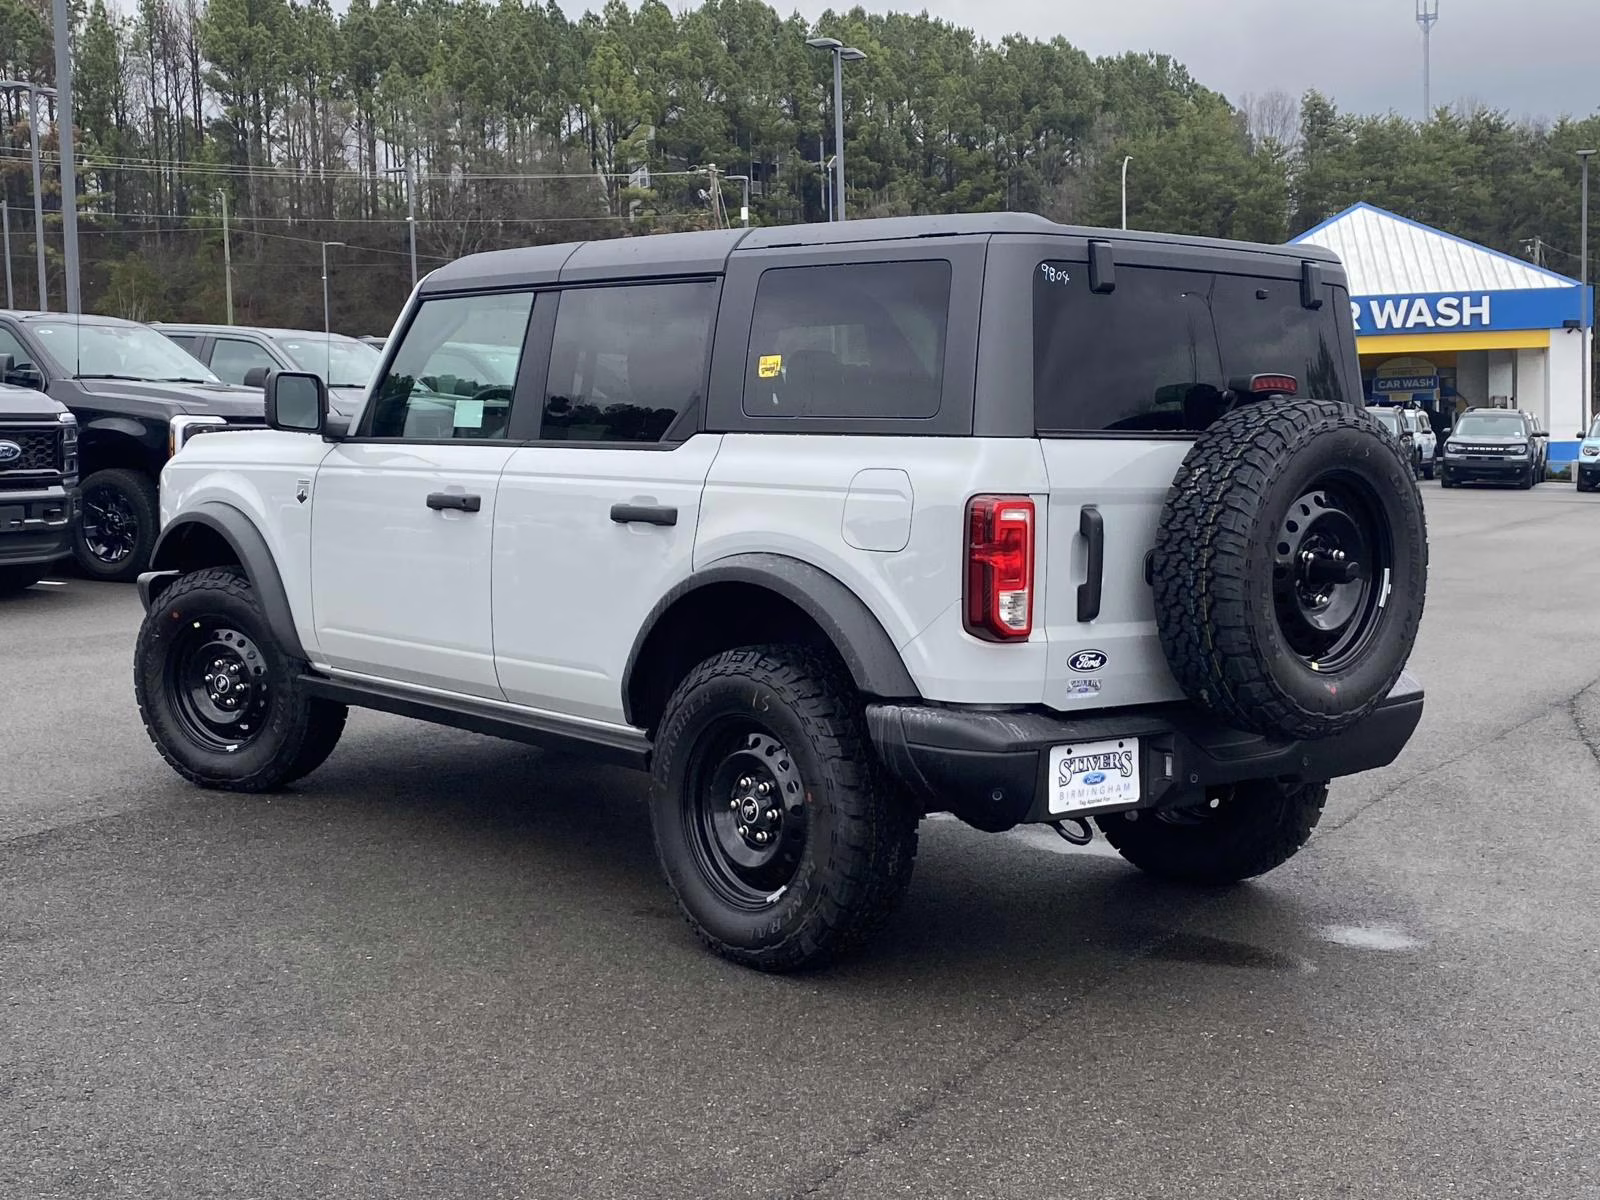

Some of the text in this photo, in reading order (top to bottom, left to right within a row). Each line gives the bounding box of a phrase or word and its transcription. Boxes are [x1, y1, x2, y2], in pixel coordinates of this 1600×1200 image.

[1041, 263, 1070, 285] 9804
[1369, 295, 1490, 329] WASH
[1378, 378, 1434, 389] CAR WASH
[1075, 653, 1102, 669] Ford
[1058, 750, 1133, 787] STIVERS
[1059, 783, 1131, 800] BIRMINGHAM
